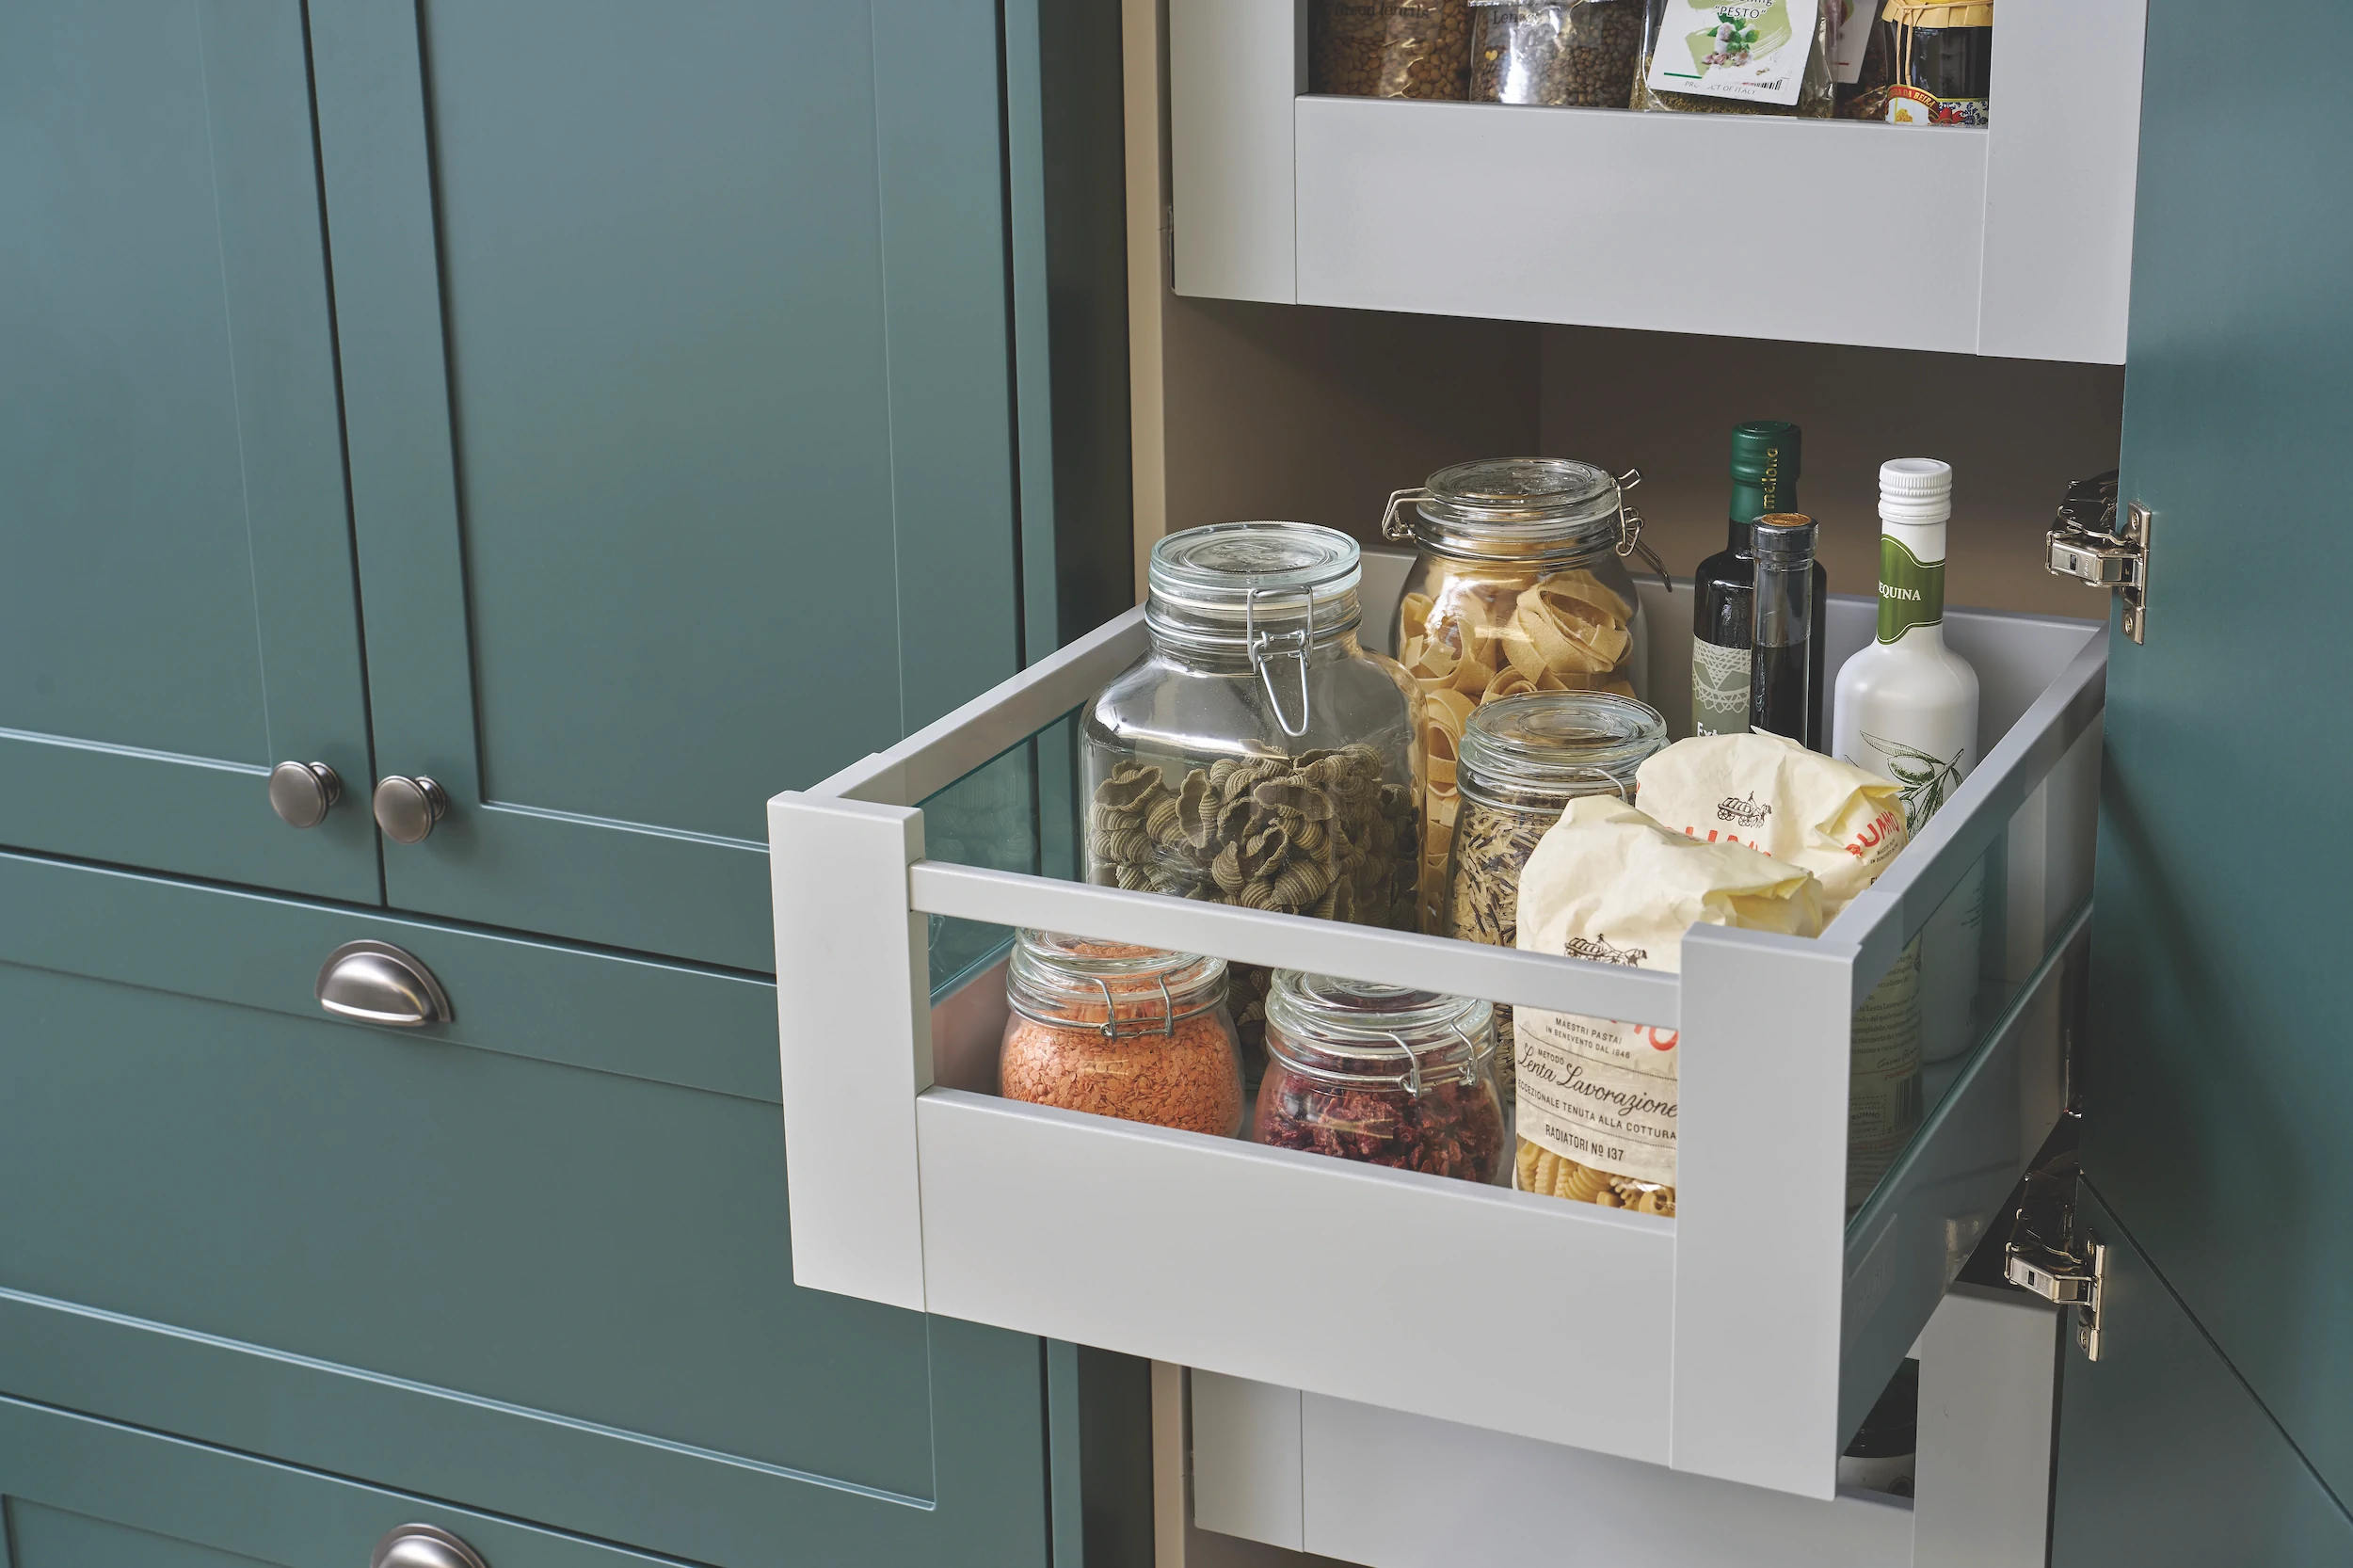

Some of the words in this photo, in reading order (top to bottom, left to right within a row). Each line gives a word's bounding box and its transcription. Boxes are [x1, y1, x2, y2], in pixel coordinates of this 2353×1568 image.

[1913, 91, 1937, 108] BEIRA
[1545, 1025, 1553, 1033] IN
[1554, 1031, 1593, 1048] BENEVENTO
[1594, 1043, 1609, 1054] DAL
[1612, 1049, 1631, 1060] 1846
[1555, 1016, 1589, 1036] MAESTRI
[1591, 1030, 1623, 1045] PASTAI
[1537, 1048, 1564, 1065] METODO
[1517, 1042, 1557, 1083] Lenta
[1557, 1063, 1678, 1118] Lavorazione
[1517, 1079, 1560, 1109] ECCEZIONALE
[1562, 1101, 1595, 1122] TENUTA
[1598, 1116, 1623, 1129] ALLA
[1625, 1122, 1677, 1141] COTTURA
[1545, 1124, 1589, 1152] RADIATORI
[1607, 1146, 1625, 1161] 137
